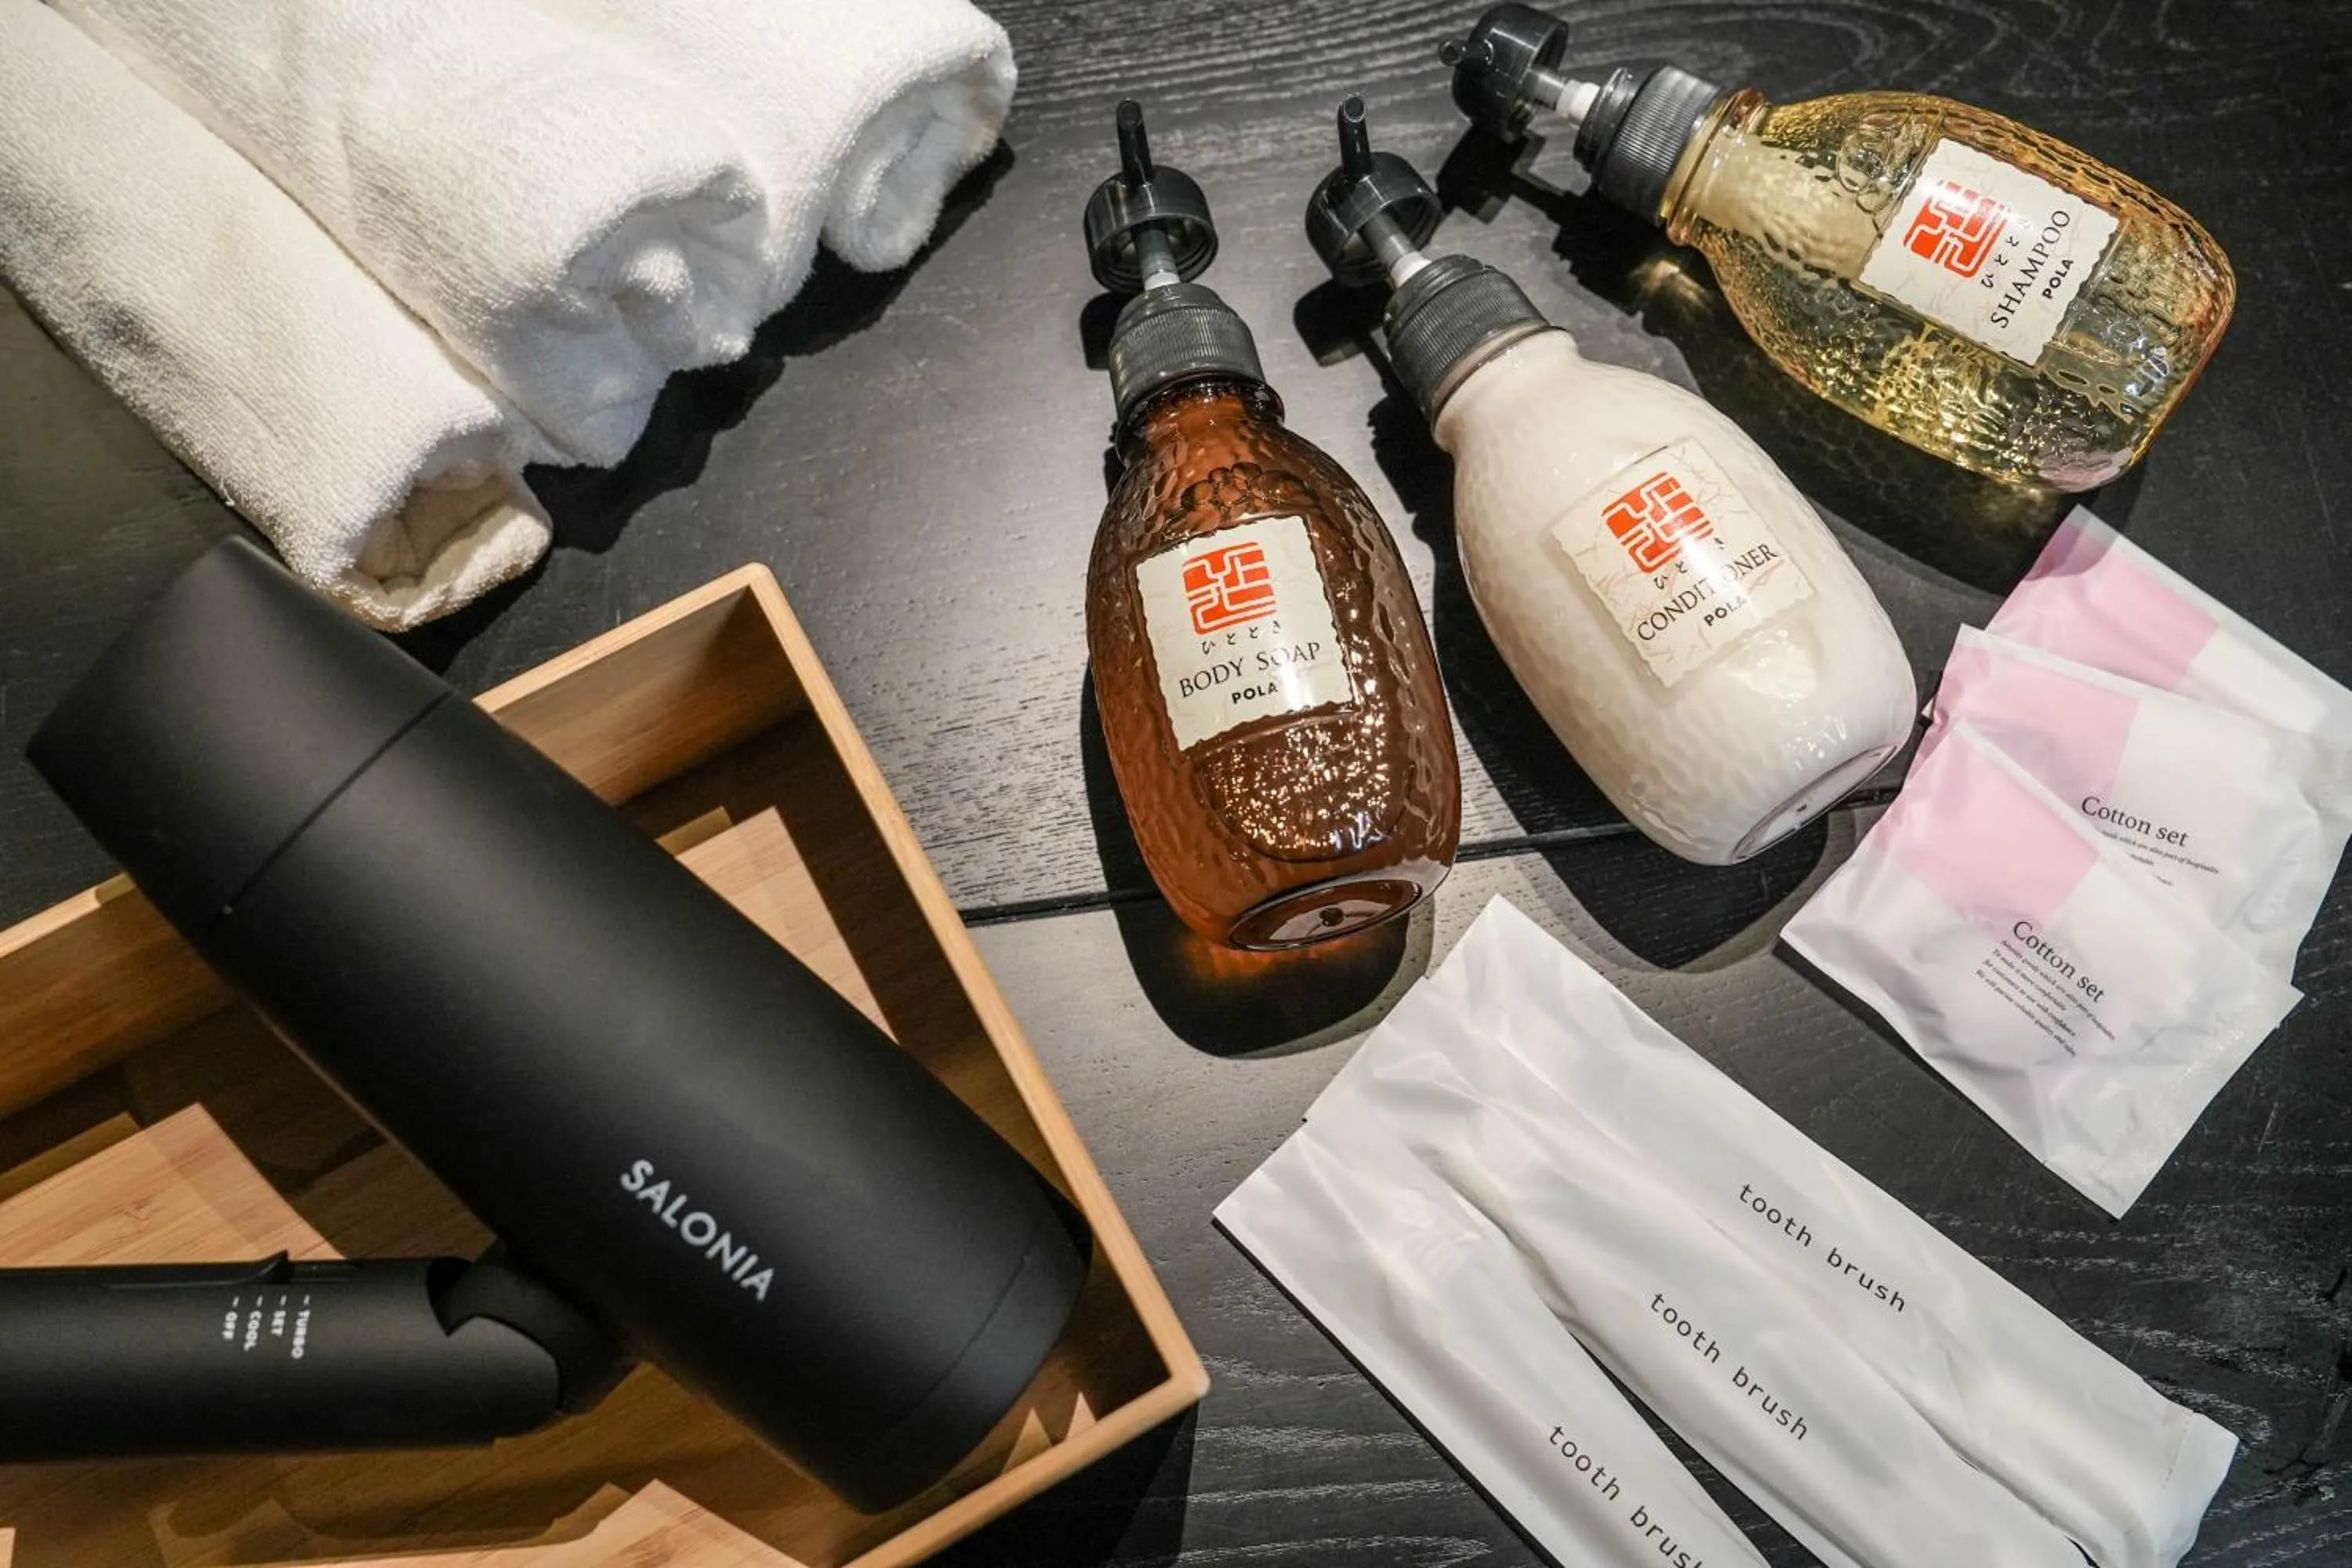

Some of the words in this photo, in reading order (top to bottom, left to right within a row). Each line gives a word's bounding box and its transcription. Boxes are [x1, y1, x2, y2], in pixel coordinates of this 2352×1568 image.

[1980, 219, 2031, 289] ひとと
[1991, 210, 2071, 328] SHAMPOO
[2042, 258, 2074, 300] POLA
[1637, 543, 1779, 641] CONDITONER
[1179, 657, 1243, 699] BODY
[1256, 641, 1320, 671] SOAP
[1232, 681, 1279, 704] POLA
[2082, 795, 2153, 835] Cotton
[2156, 826, 2190, 848] set
[2013, 920, 2076, 979] Cotton
[2076, 975, 2104, 1004] set
[620, 1159, 775, 1301] SALONIA
[1738, 1183, 1813, 1247] tooth
[1827, 1247, 1907, 1312] brush
[243, 1310, 263, 1352] COOL
[291, 1308, 311, 1359] TURBO
[1650, 1292, 1721, 1363] tooth
[1731, 1366, 1808, 1440] brush
[1548, 1425, 1621, 1501] tooth
